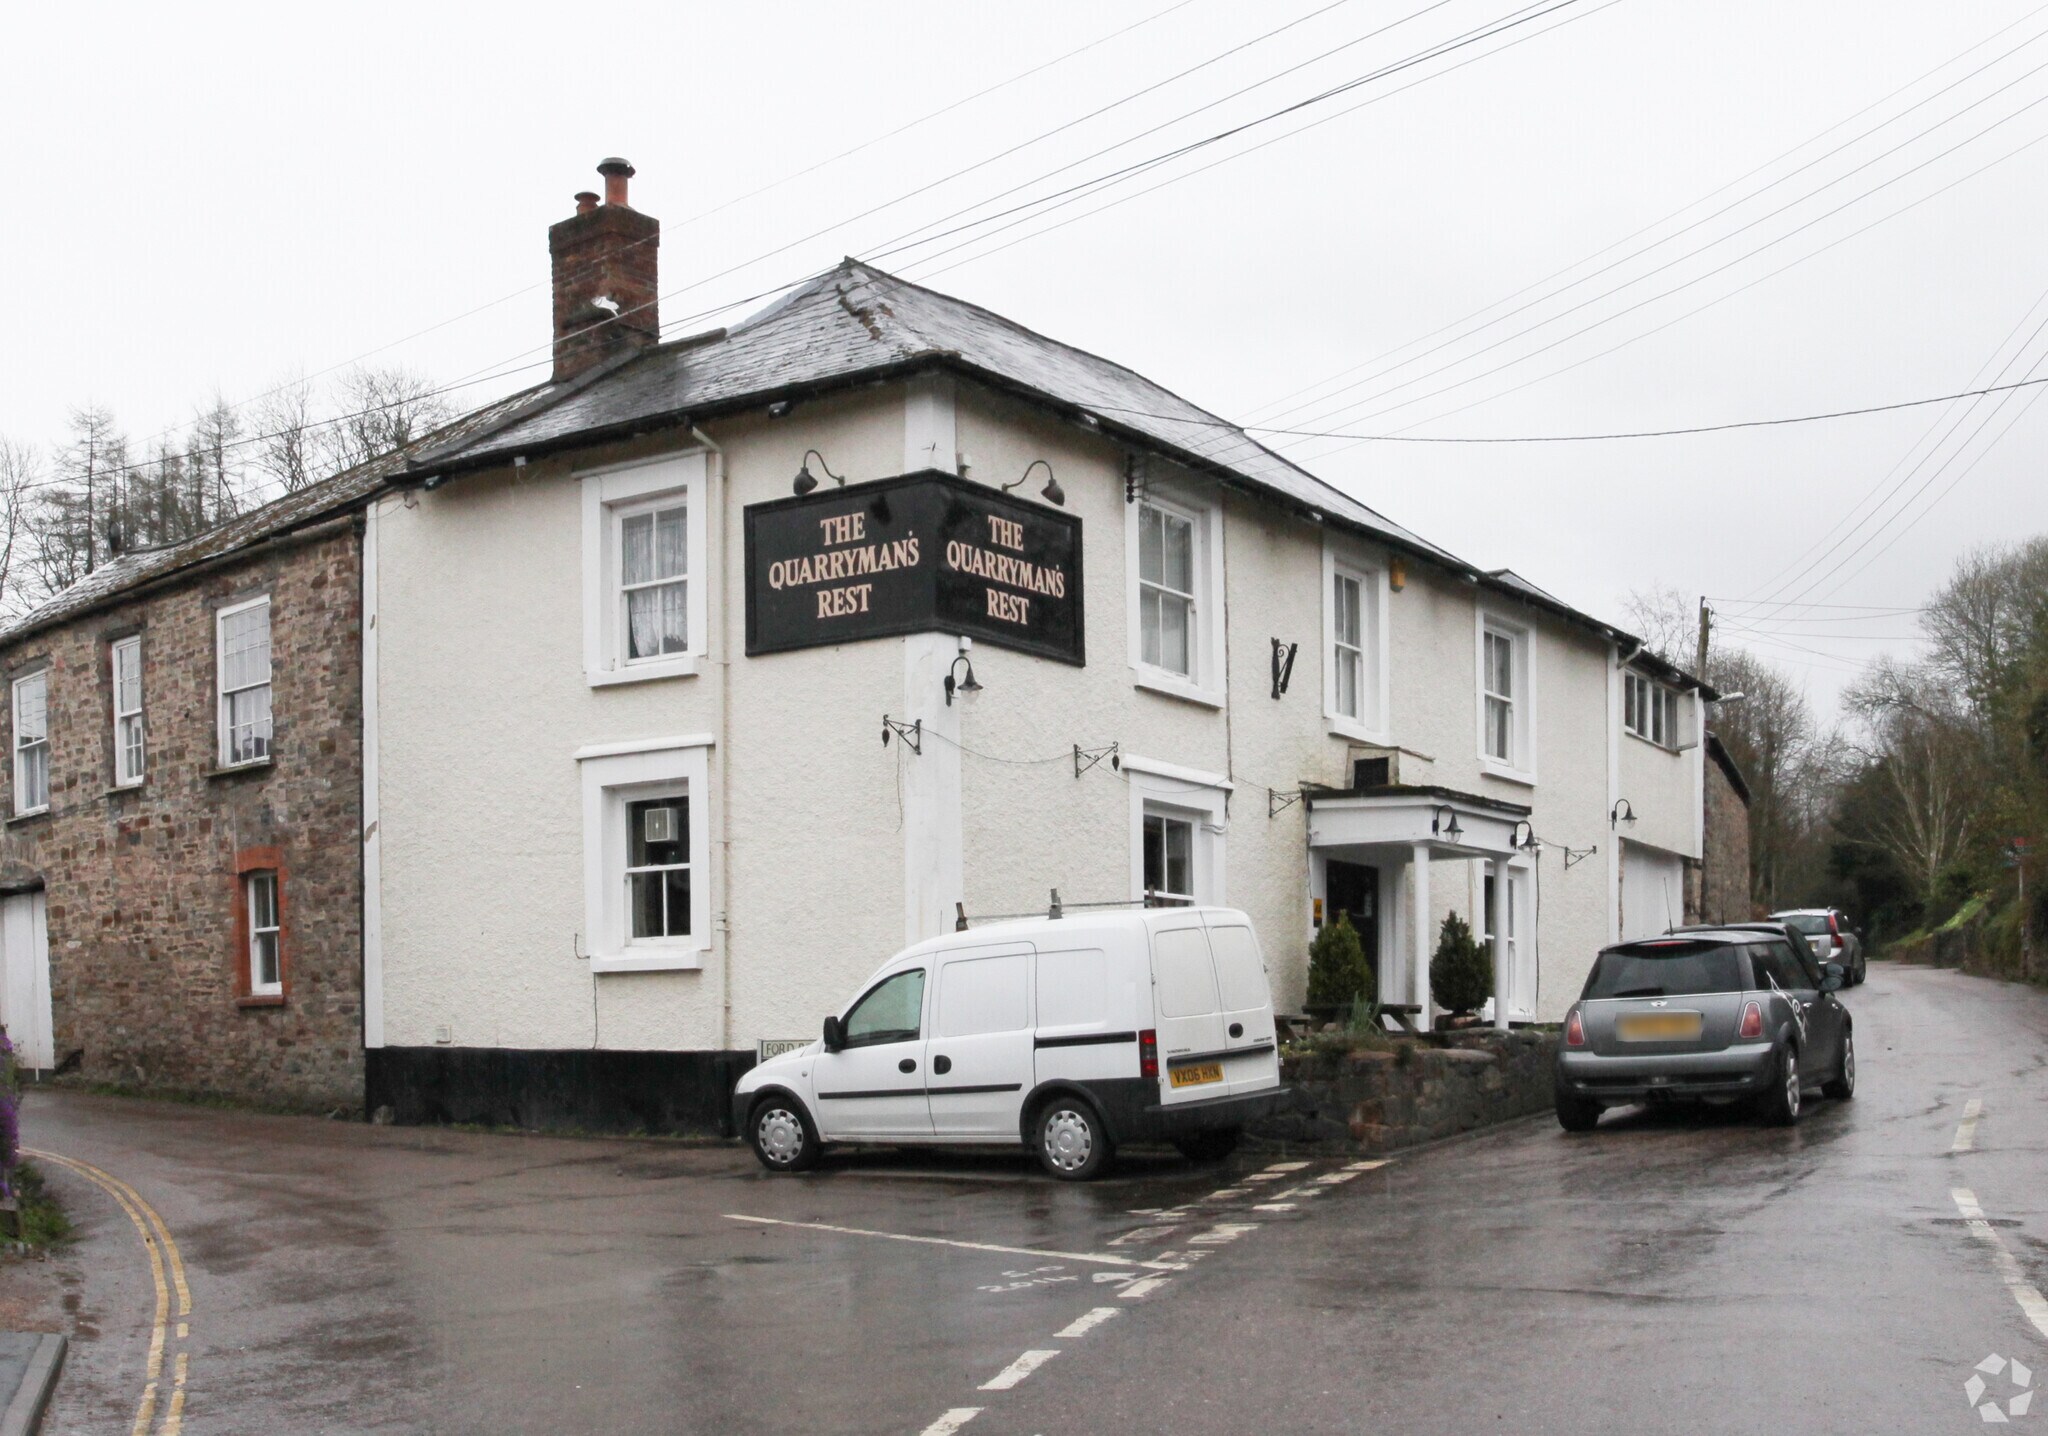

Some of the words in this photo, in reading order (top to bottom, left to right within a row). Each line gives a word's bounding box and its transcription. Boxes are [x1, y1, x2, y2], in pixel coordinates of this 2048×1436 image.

[820, 512, 866, 546] THE
[988, 515, 1024, 551] THE
[769, 530, 920, 590] QUARRYMAN'S
[946, 541, 1065, 599] QUARRYMAN'S
[817, 584, 872, 618] REST
[986, 588, 1029, 625] REST
[766, 1043, 795, 1055] FORD
[1173, 1068, 1201, 1083] VX06
